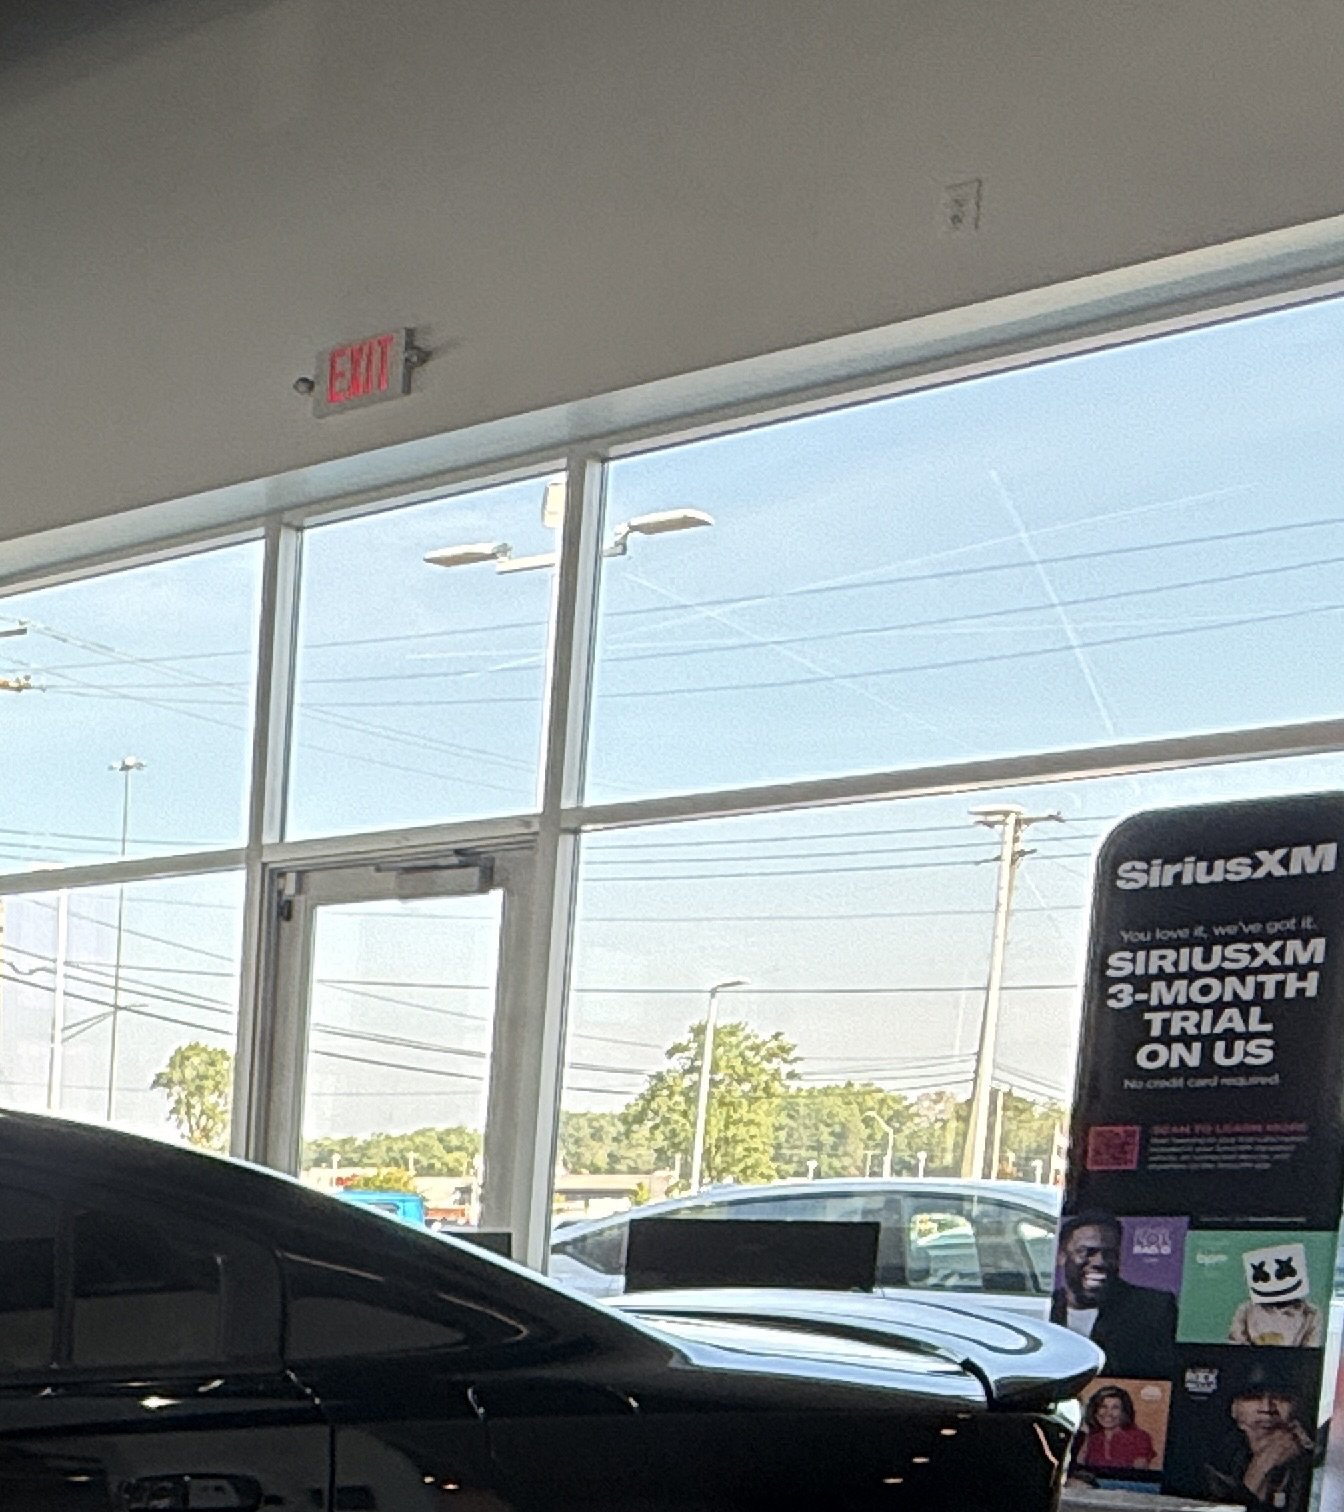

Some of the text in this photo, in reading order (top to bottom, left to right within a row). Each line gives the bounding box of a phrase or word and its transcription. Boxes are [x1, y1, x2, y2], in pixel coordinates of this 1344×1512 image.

[328, 333, 394, 404] EXIT
[1116, 842, 1338, 890] SiriusXM
[1120, 929, 1151, 943] You
[1156, 926, 1190, 940] love
[1212, 920, 1263, 937] we've
[1265, 916, 1297, 934] got
[1105, 936, 1326, 978] SIRIUSXM
[1106, 971, 1320, 1009] 3-MONTH
[1143, 1006, 1274, 1037] TRIAL
[1136, 1038, 1276, 1070] ON US
